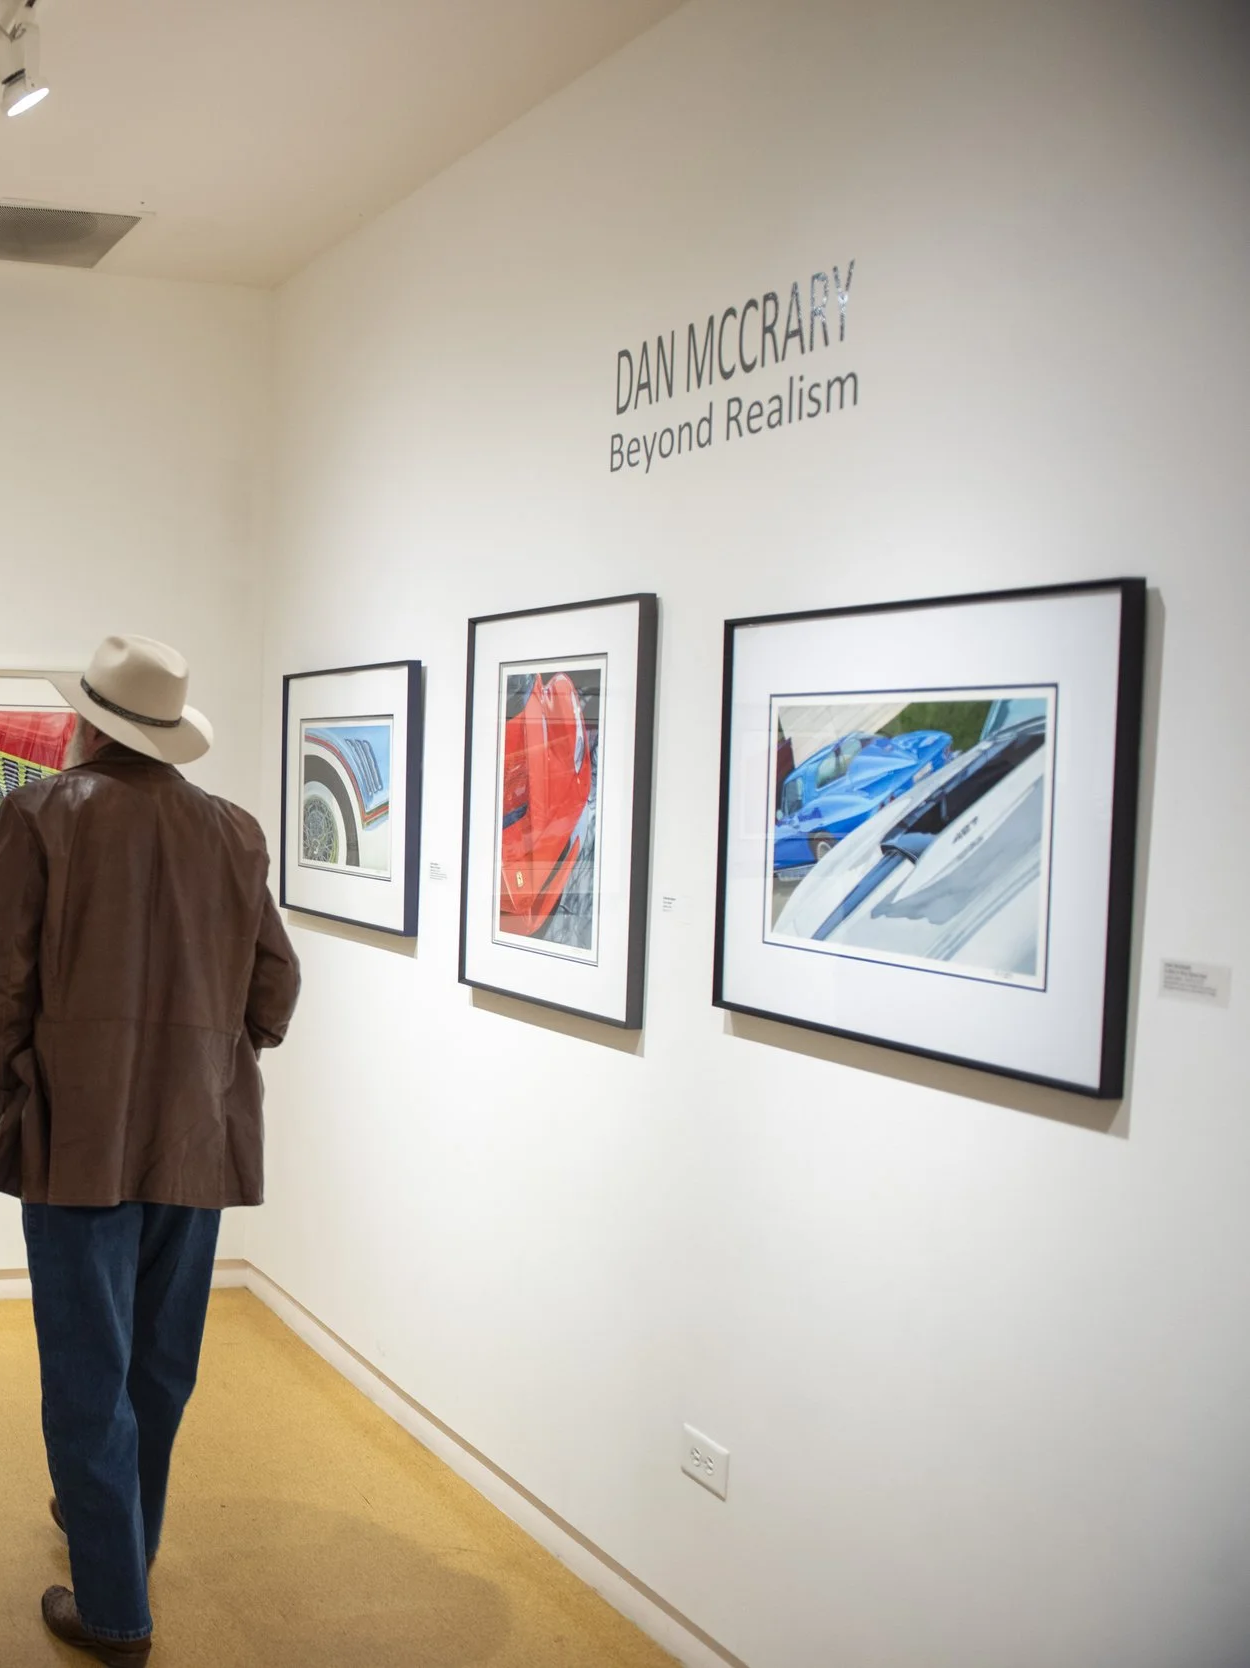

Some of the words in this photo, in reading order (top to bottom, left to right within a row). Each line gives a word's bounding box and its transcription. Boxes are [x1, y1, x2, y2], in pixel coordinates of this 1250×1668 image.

[616, 330, 675, 415] DAN
[686, 258, 855, 392] MCCRARY
[610, 401, 713, 474] Beyond
[726, 372, 858, 441] Realism
